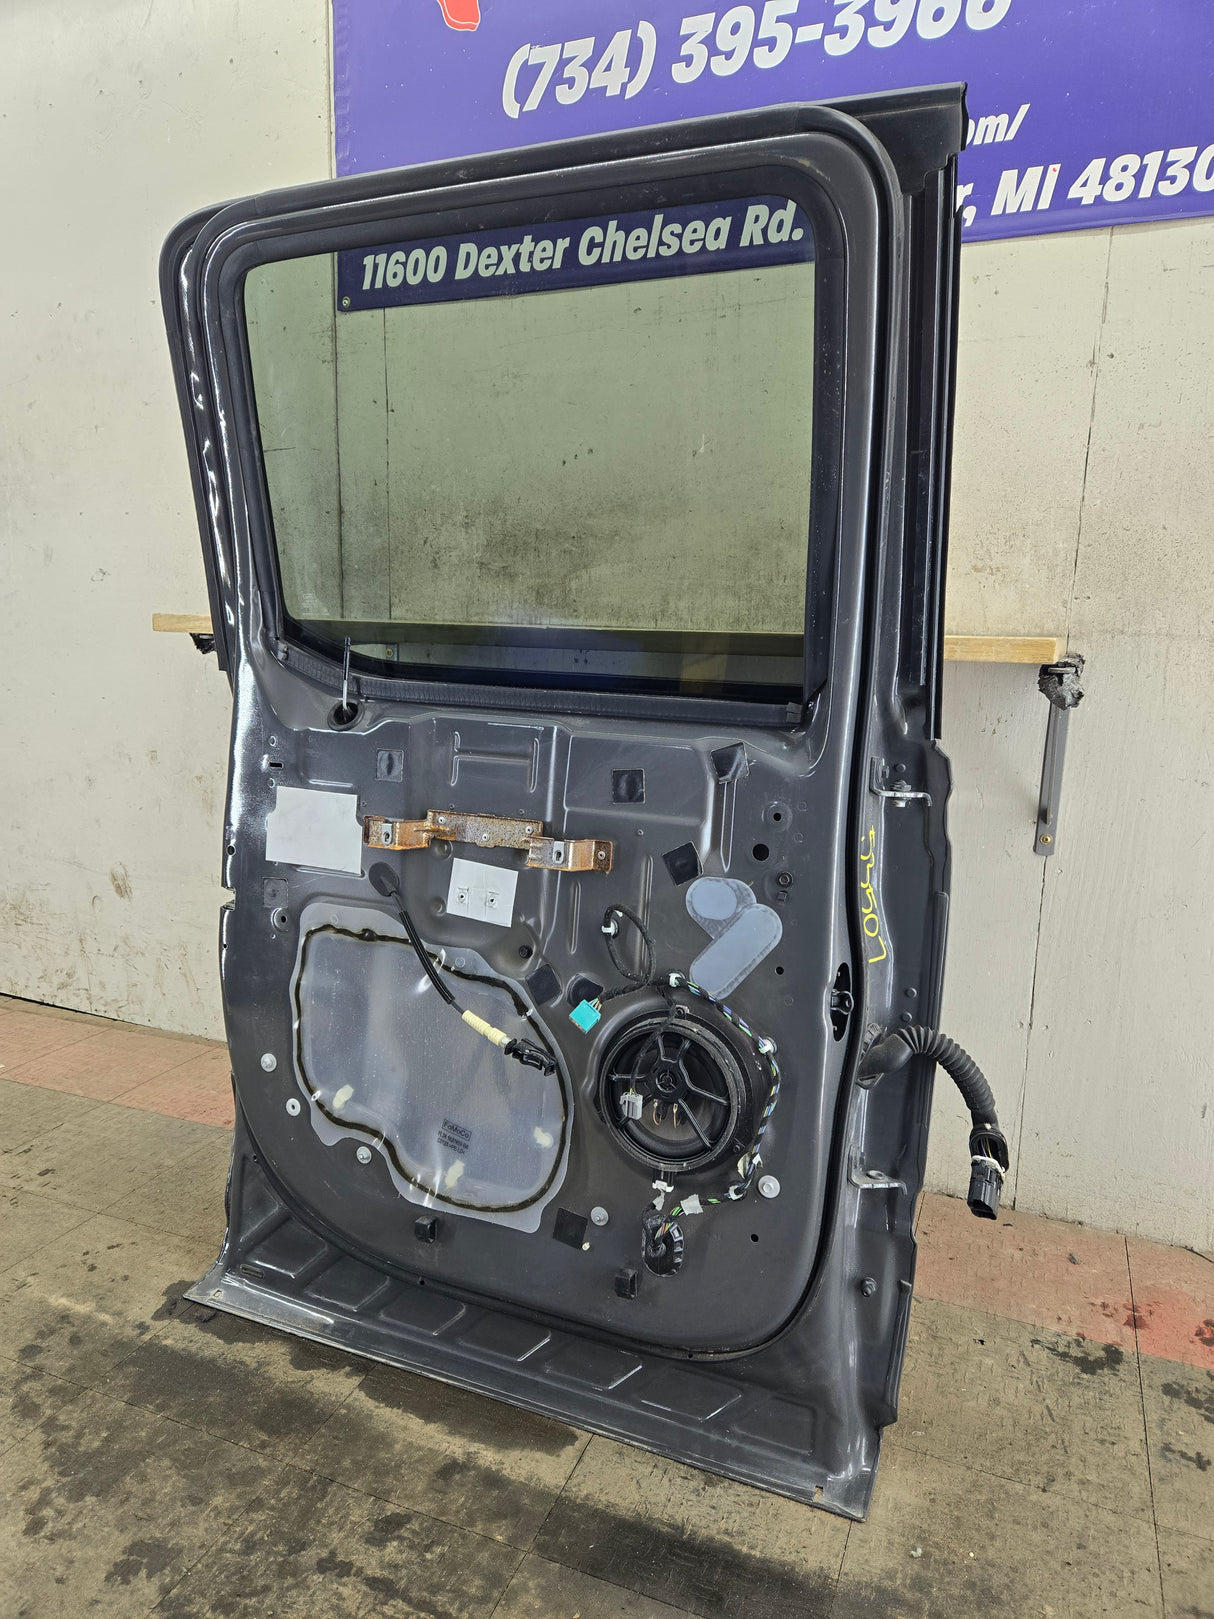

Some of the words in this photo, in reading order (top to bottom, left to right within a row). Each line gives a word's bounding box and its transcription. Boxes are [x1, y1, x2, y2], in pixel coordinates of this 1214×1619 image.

[503, 21, 657, 118] (734)
[990, 164, 1061, 216] MI
[362, 246, 448, 290] 11600
[454, 236, 570, 281] Dexter
[578, 214, 732, 264] Chelsea
[739, 199, 804, 248] Rd.
